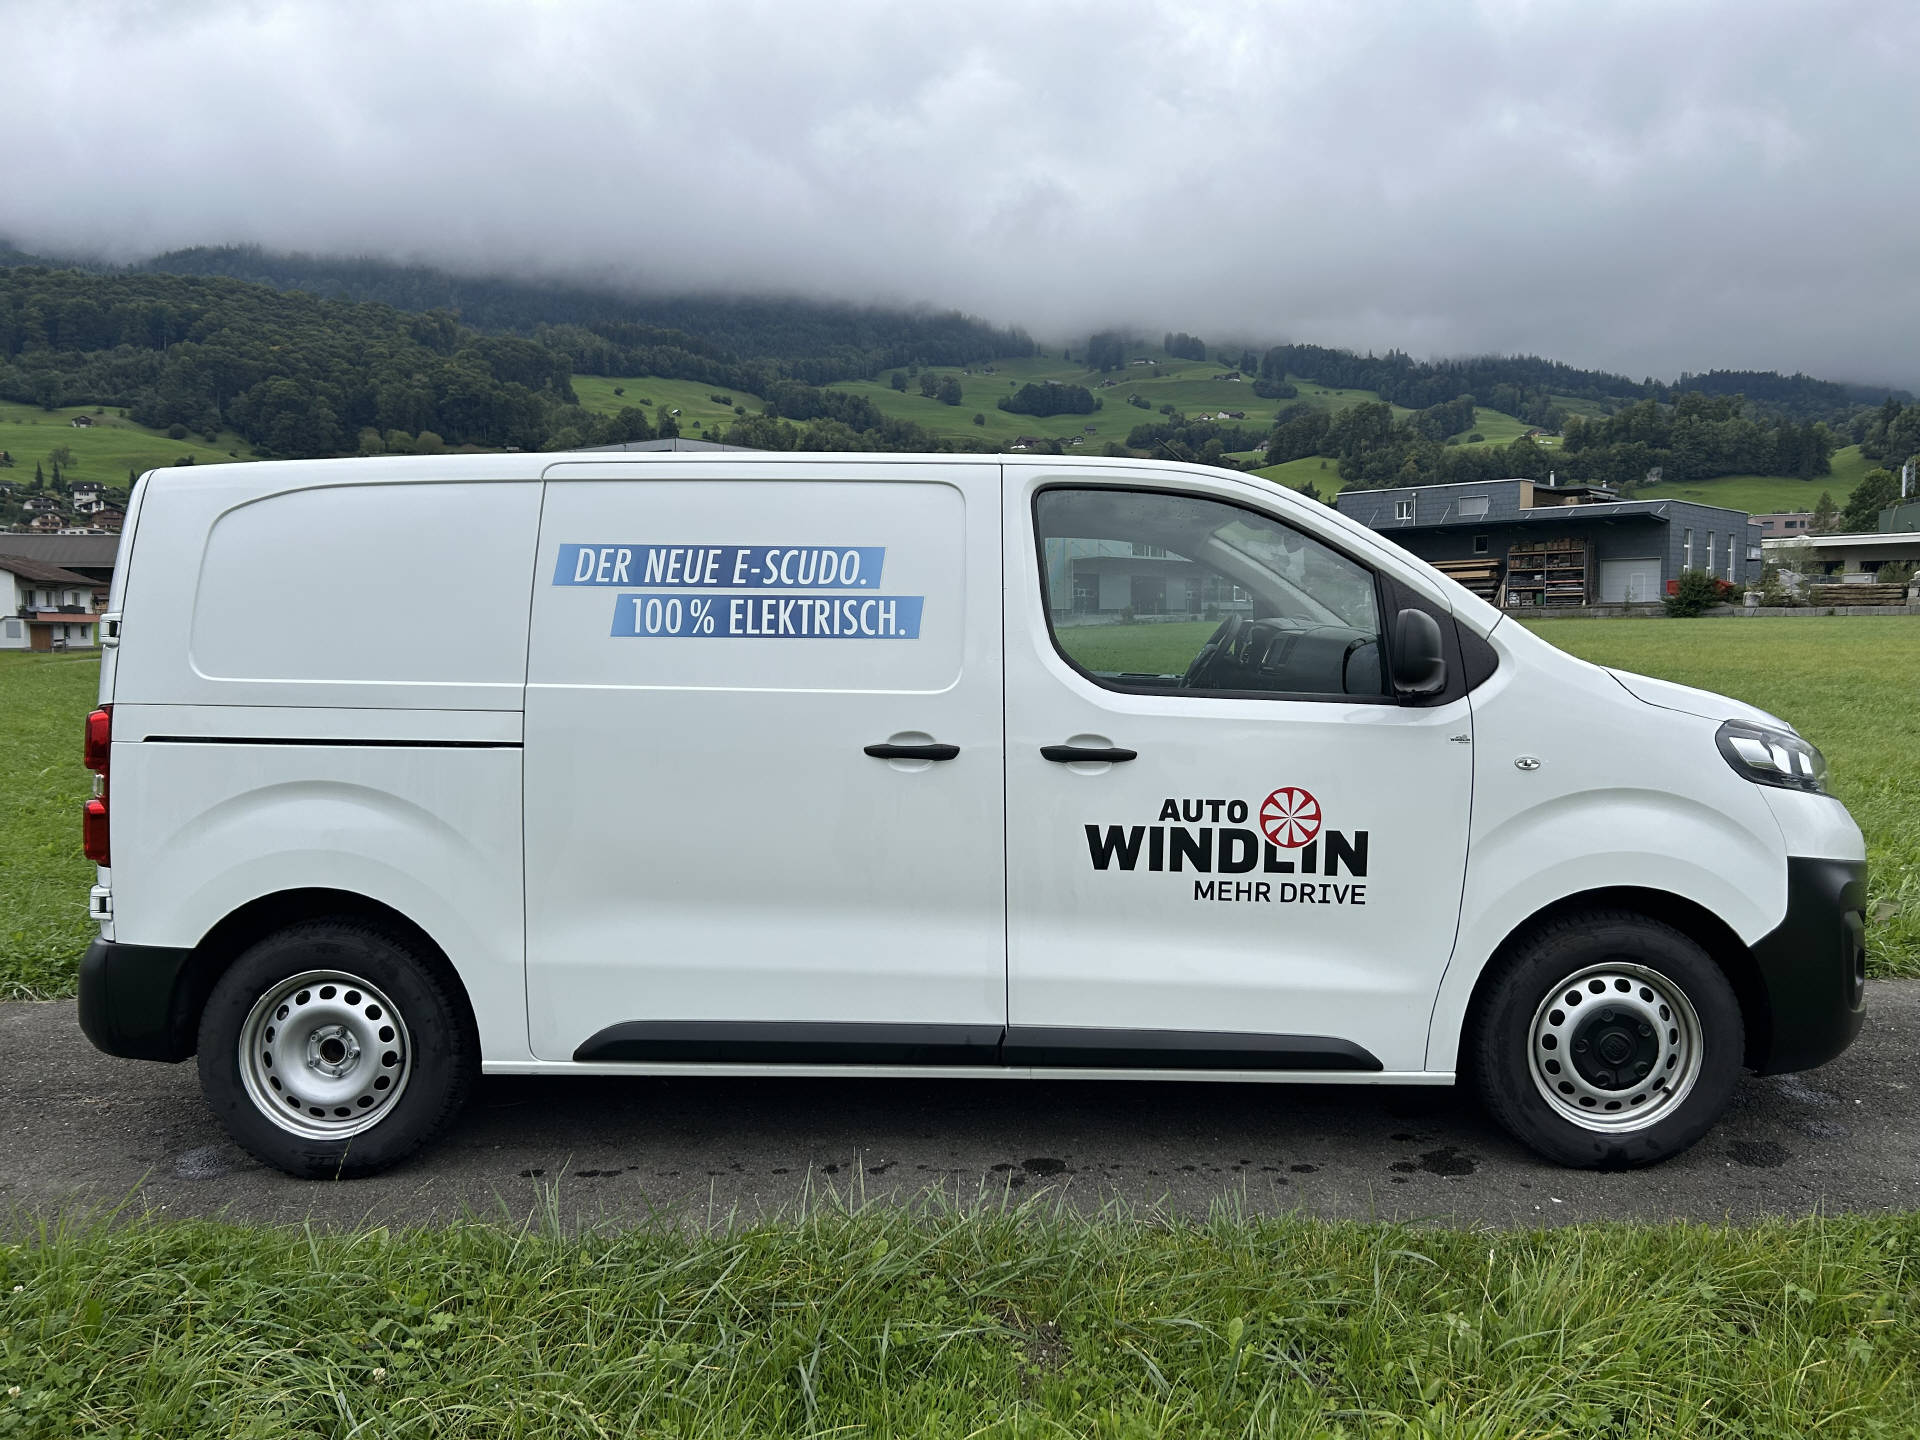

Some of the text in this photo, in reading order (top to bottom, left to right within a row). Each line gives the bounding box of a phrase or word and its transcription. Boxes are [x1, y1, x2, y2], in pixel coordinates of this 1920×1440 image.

[573, 548, 867, 585] DER NEUE E-SCUDO.
[632, 598, 906, 635] 100 % ELEKTRISCH.
[1158, 798, 1249, 824] AUTO
[1084, 824, 1369, 877] WINDLIN
[1194, 880, 1367, 905] MEHR DRIVE
